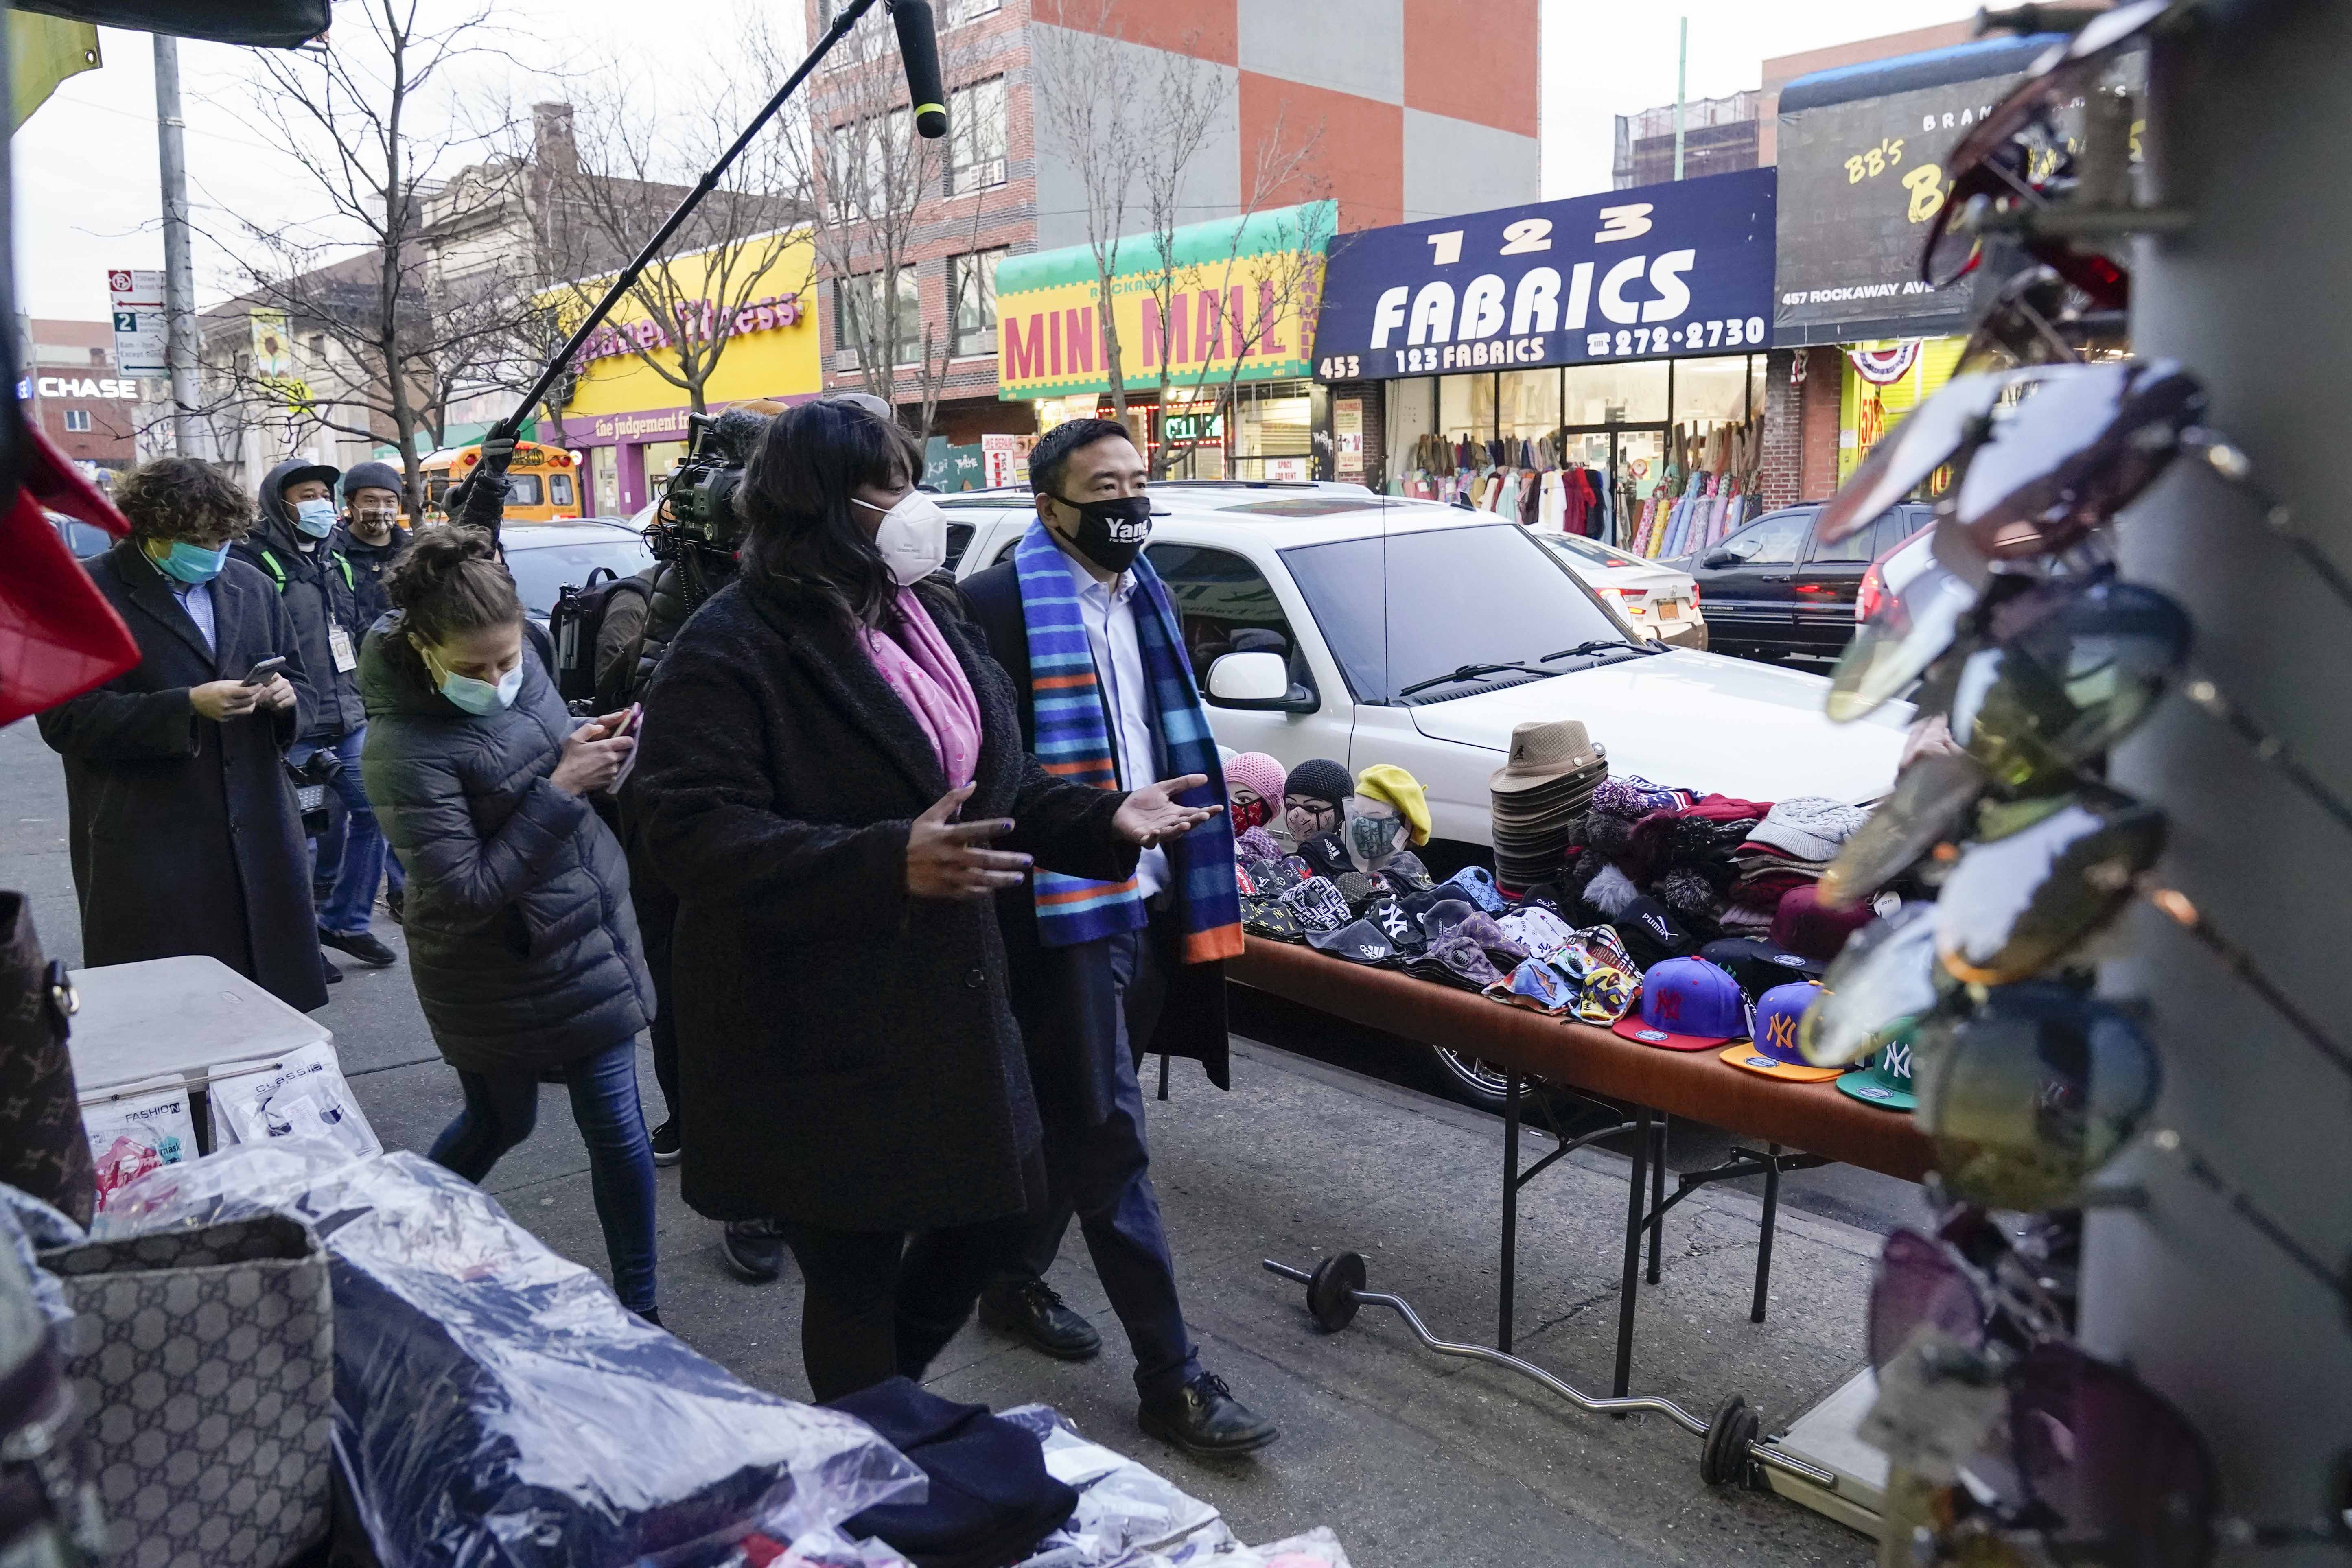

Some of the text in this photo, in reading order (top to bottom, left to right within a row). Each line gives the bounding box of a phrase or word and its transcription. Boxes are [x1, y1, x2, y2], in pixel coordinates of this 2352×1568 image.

[1923, 105, 1992, 131] BRAN
[1844, 137, 1904, 184] BB'S
[1428, 203, 1654, 265] 1 2 3
[1090, 275, 1175, 297] RCKAWAY
[1782, 292, 1807, 305] 457
[1810, 283, 1899, 303] ROCKAWAY
[1370, 249, 1695, 349] FABRICS
[118, 314, 131, 330] 2
[1142, 281, 1286, 368] MALL
[1395, 337, 1544, 373] 123 FABRICS
[1320, 356, 1360, 379] 453
[38, 377, 138, 399] CHASE
[596, 410, 689, 441] the judgement fr
[985, 437, 1013, 448] WE REPAIR
[1278, 461, 1292, 469] SPACE
[1324, 839, 1334, 860] adidas
[1235, 865, 1251, 894] Suprem
[1379, 903, 1408, 938] NY
[1642, 913, 1665, 936] PUMA
[1359, 944, 1378, 959] adid
[1654, 988, 1682, 1020] NY
[1766, 1011, 1797, 1049] NY
[1883, 1040, 1913, 1079] NY
[125, 1102, 180, 1123] FASHION
[160, 1142, 182, 1155] mask
